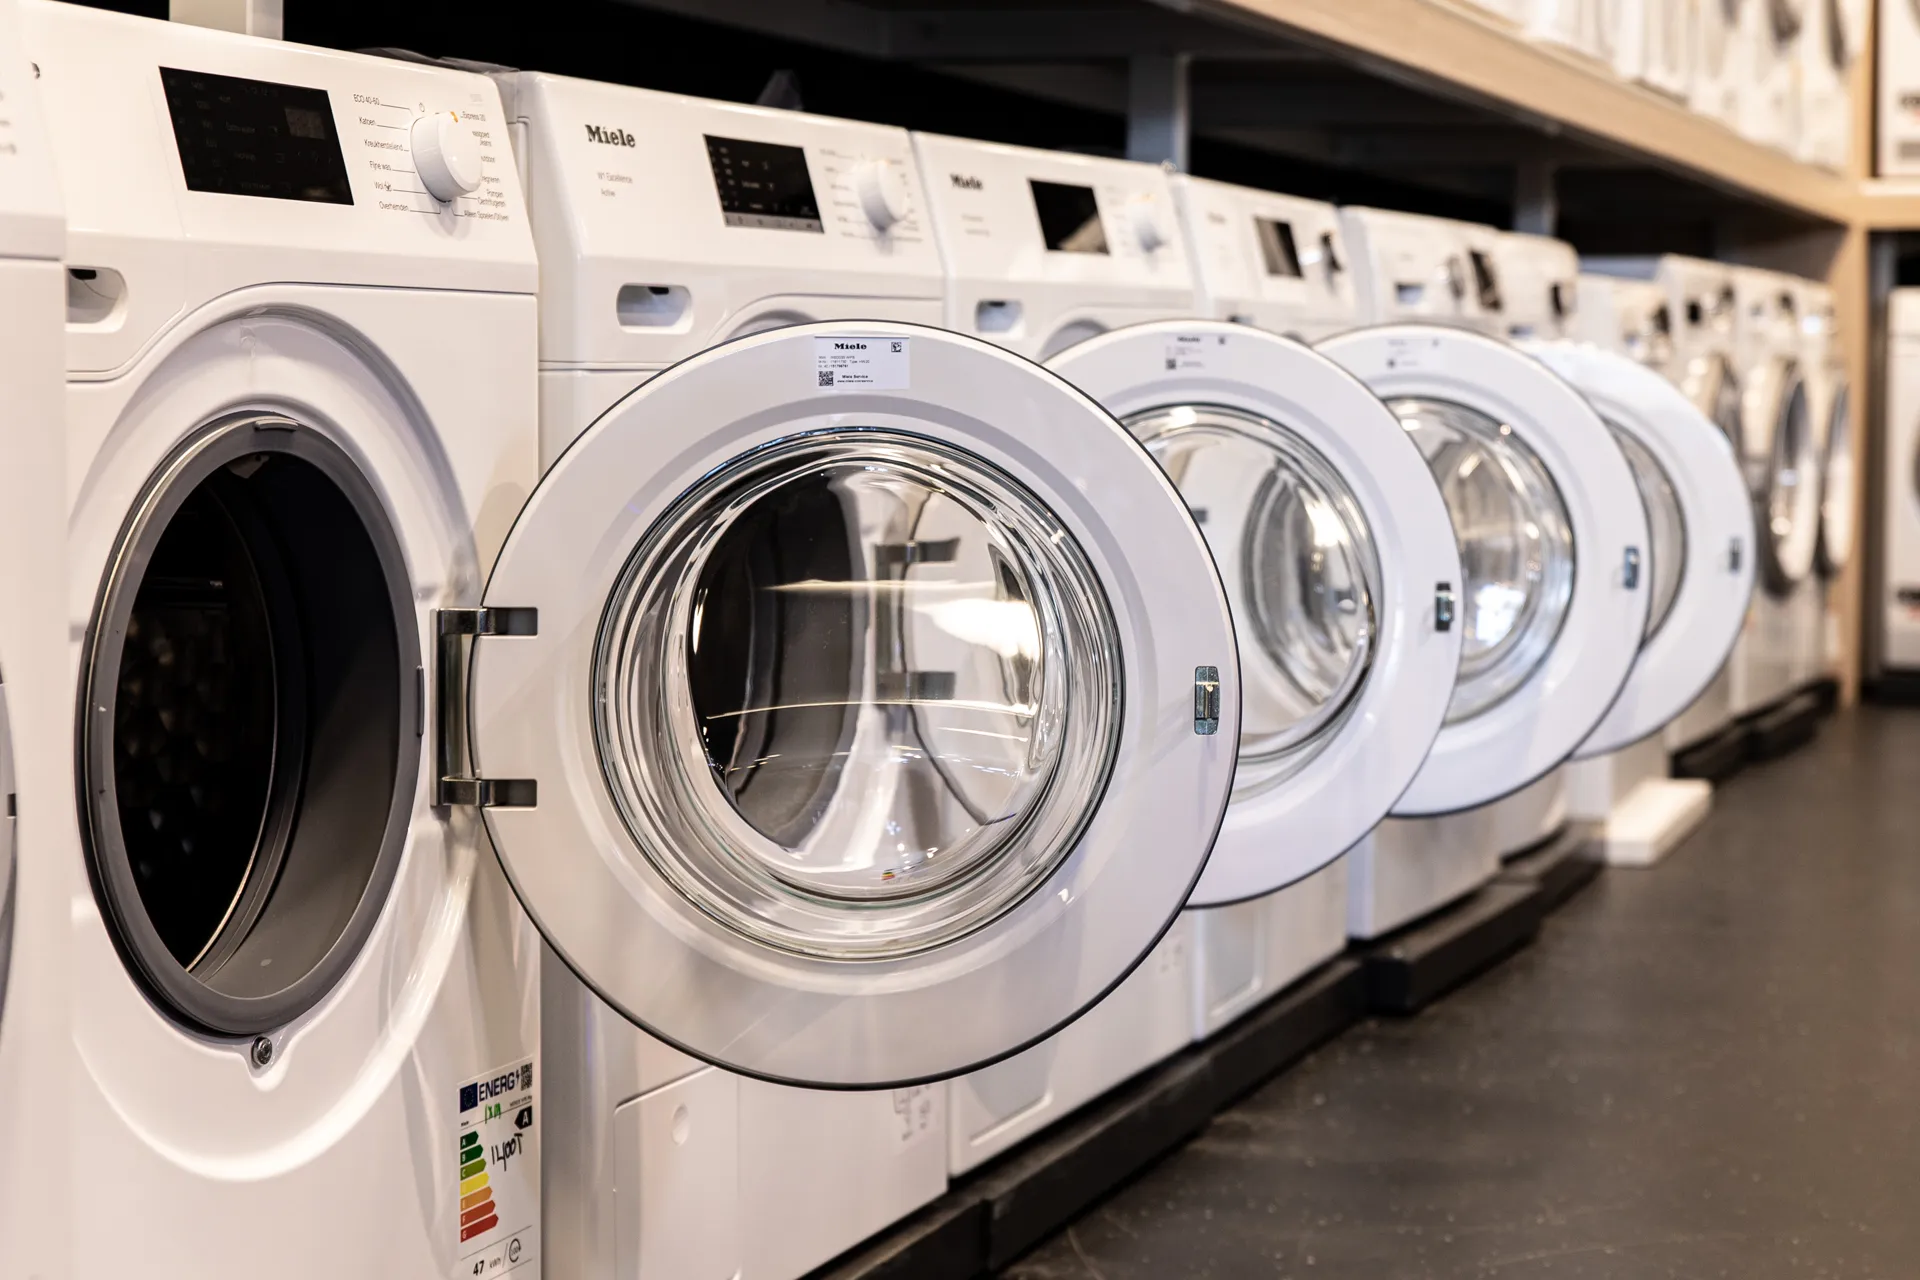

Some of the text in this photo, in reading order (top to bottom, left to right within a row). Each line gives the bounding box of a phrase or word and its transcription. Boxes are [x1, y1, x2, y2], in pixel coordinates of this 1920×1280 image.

[584, 124, 636, 148] Miele
[950, 173, 984, 190] Miele
[834, 342, 867, 350] Miele
[479, 1072, 515, 1103] ENERG
[523, 1111, 529, 1126] A
[491, 1133, 523, 1172] 1400T
[473, 1259, 485, 1276] 47
